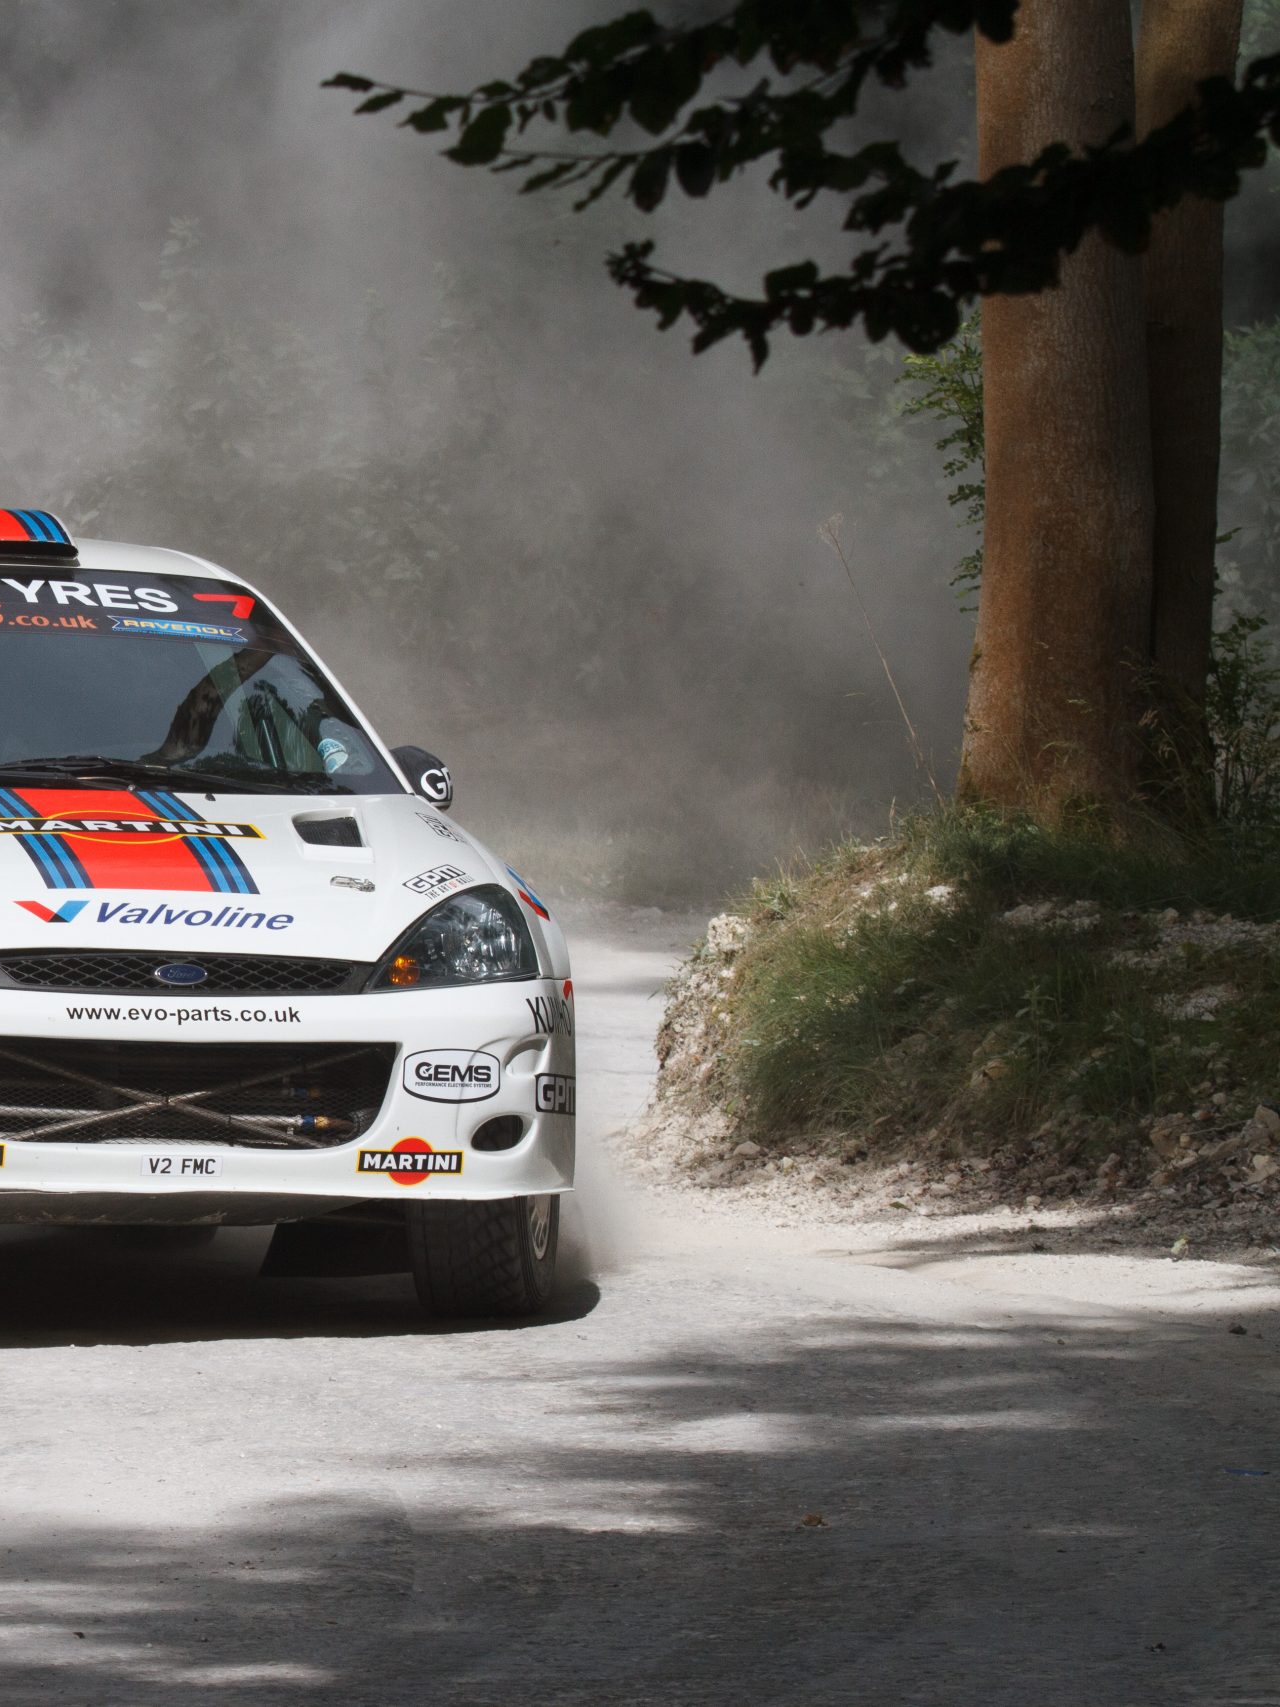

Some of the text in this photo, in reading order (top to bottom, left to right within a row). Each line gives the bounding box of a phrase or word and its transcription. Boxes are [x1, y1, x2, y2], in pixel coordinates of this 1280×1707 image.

[403, 864, 466, 893] GPM
[97, 902, 294, 930] Valvoline
[66, 1006, 301, 1025] www.evo-parts.co.uk
[525, 996, 571, 1037] KUMHO
[415, 1062, 491, 1082] GEMS
[148, 1158, 217, 1175] V2 FMC
[363, 1153, 458, 1172] MARTINI
